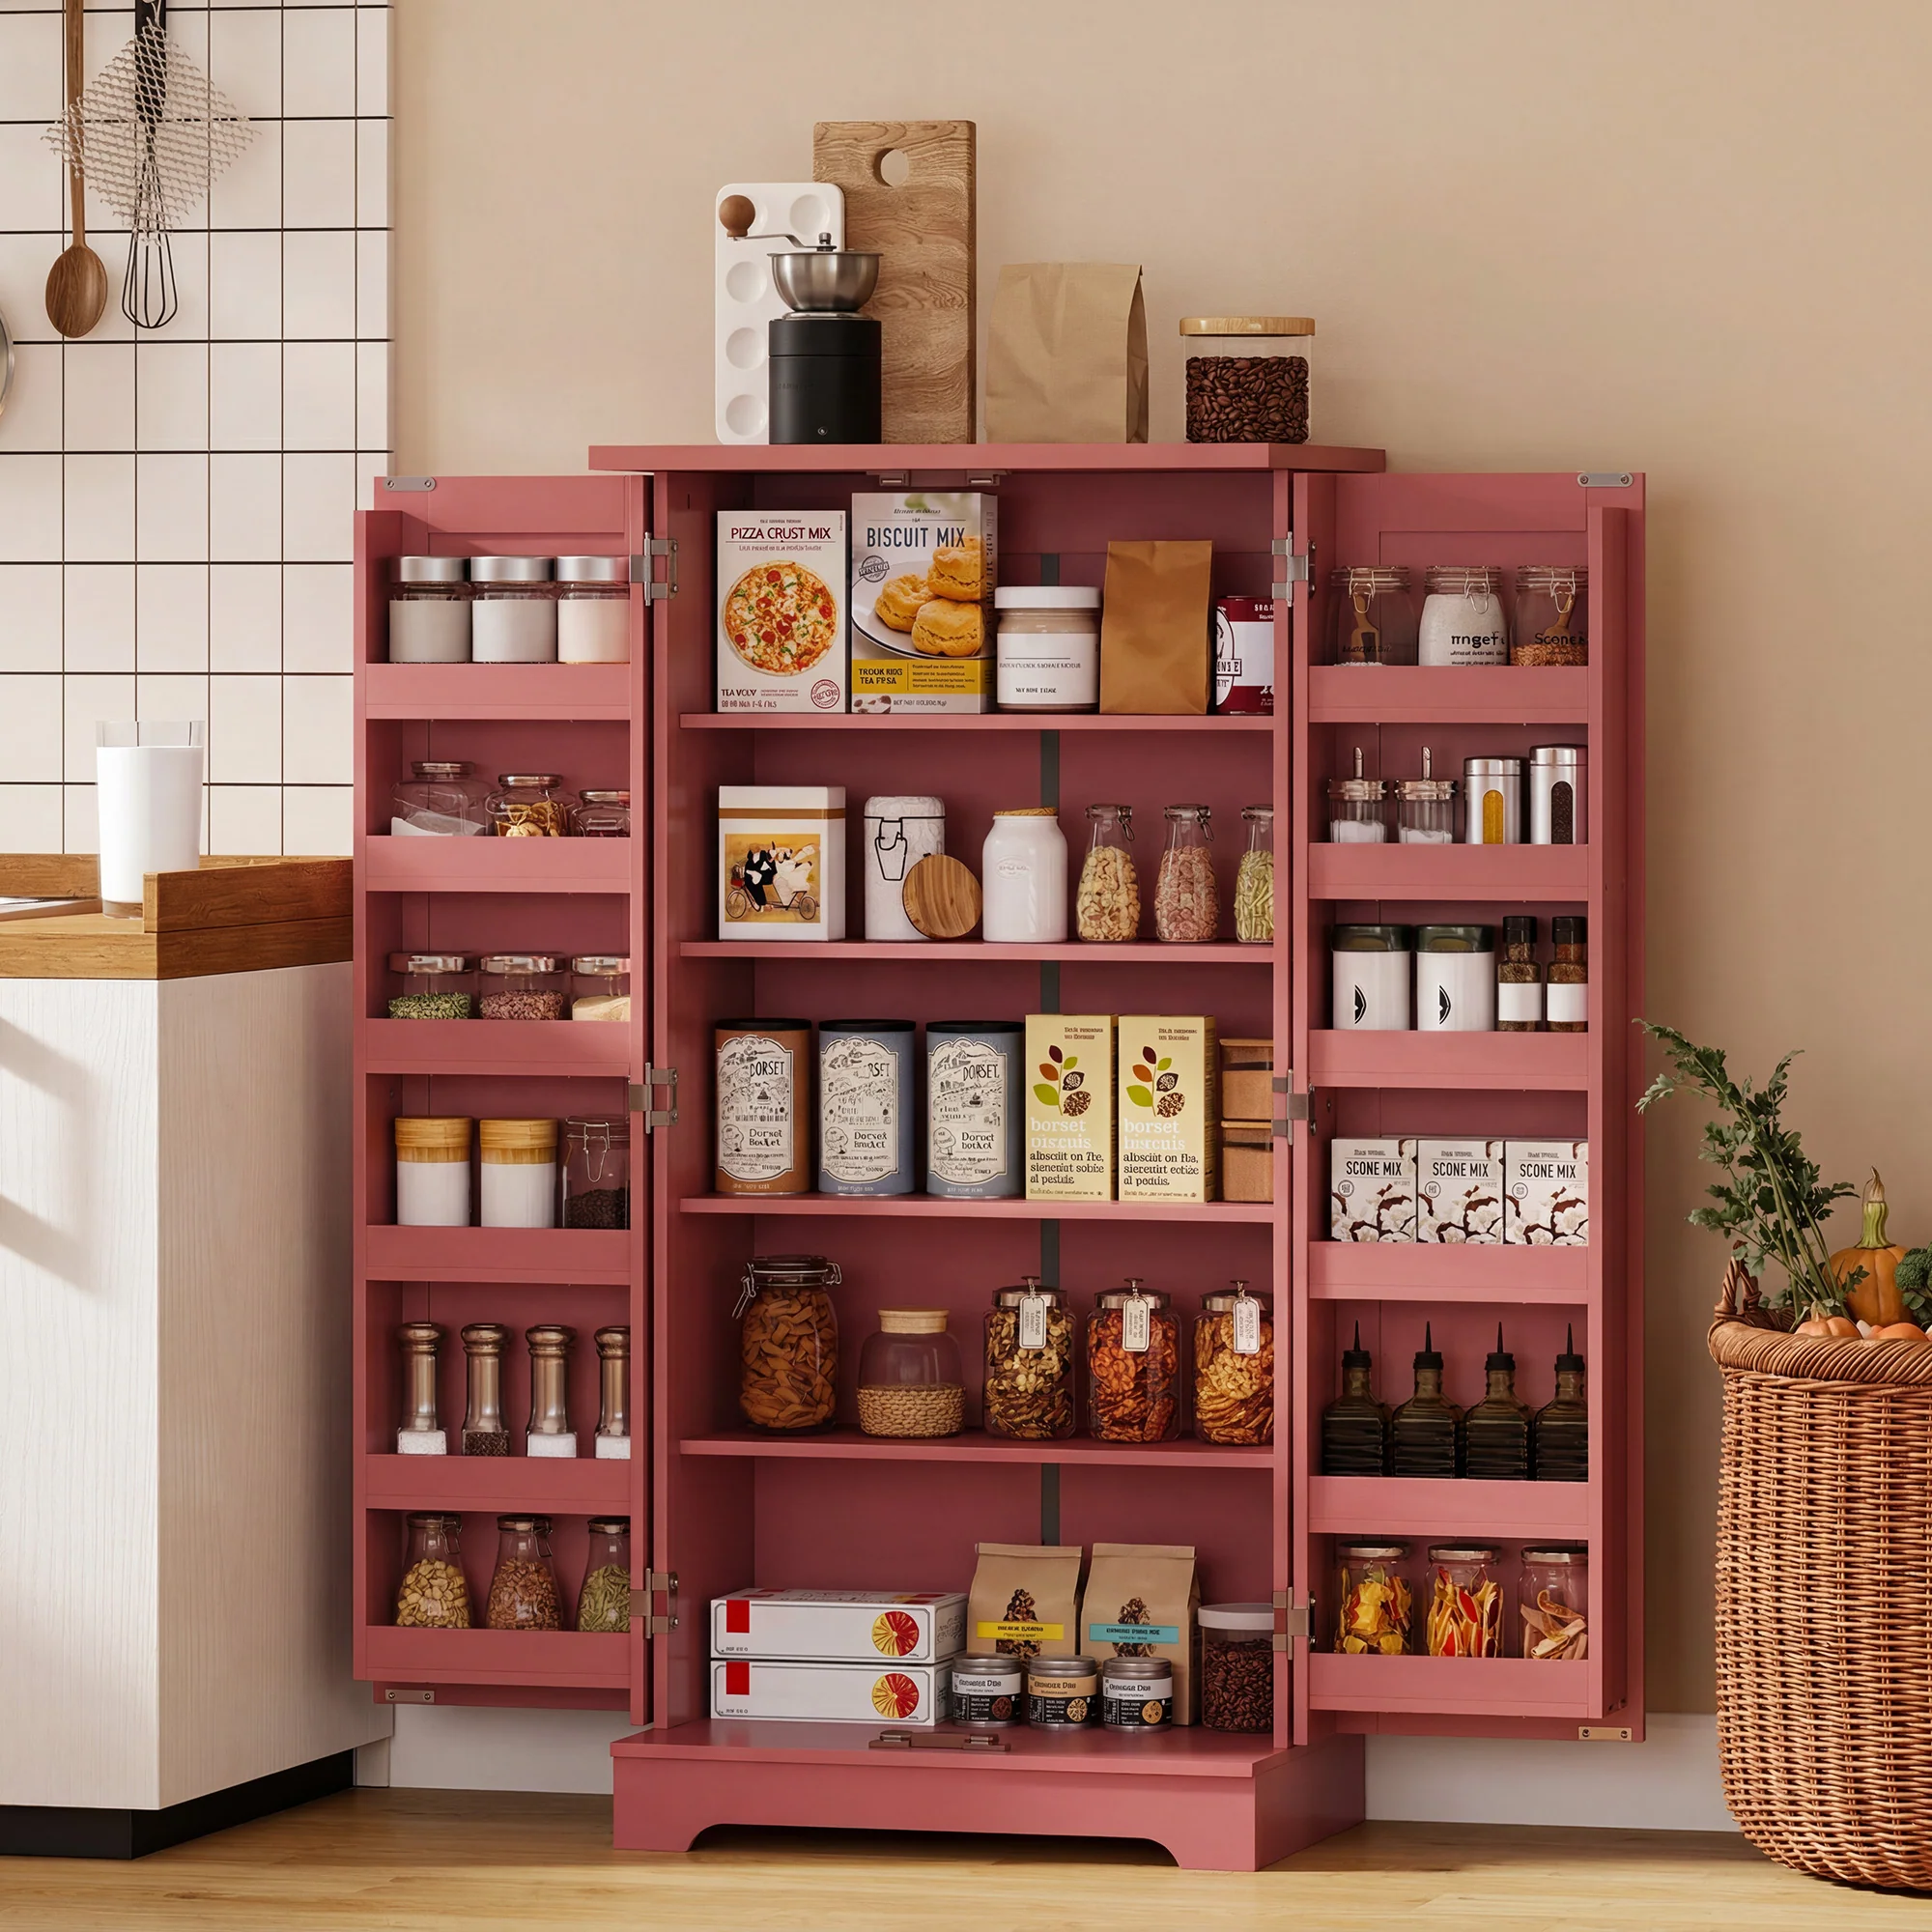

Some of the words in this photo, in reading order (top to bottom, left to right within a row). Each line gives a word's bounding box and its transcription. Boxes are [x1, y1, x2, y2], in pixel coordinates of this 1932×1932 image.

[730, 527, 764, 540] PIZZA
[767, 527, 806, 540] CRUST
[808, 527, 831, 540] MIX
[867, 527, 928, 548] BISCUIT
[936, 527, 966, 548] MIX
[750, 1061, 784, 1077] DORSET
[1030, 1117, 1087, 1132] borset
[1123, 1118, 1180, 1134] borset
[1070, 1152, 1083, 1161] on
[1164, 1154, 1178, 1163] on
[1346, 1160, 1379, 1176] SCONE
[1383, 1161, 1402, 1176] MIX
[1433, 1161, 1466, 1177] SCONE
[1469, 1162, 1489, 1178] MIX
[1520, 1163, 1553, 1178] SCONE
[1557, 1164, 1576, 1179] MIX
